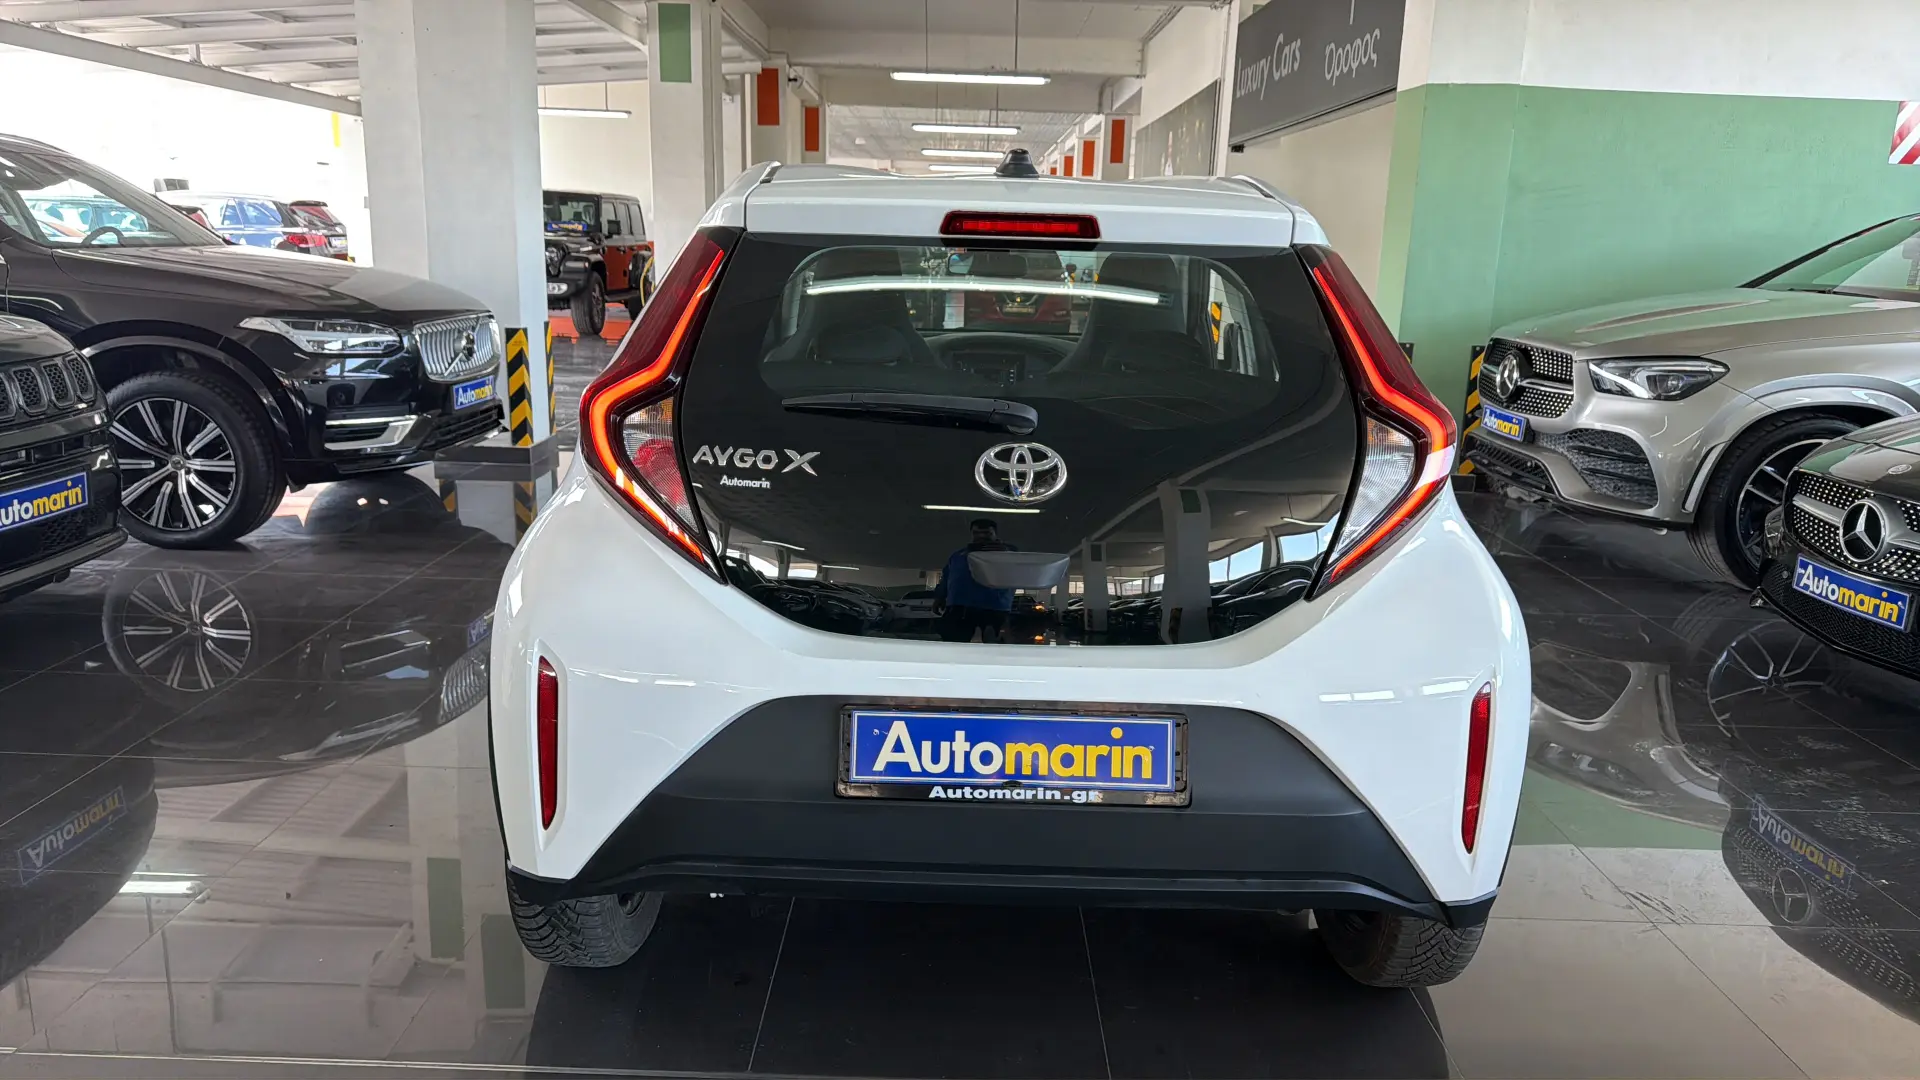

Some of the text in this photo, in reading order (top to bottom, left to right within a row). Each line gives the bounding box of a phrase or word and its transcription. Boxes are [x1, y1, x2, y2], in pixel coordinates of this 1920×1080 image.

[1236, 33, 1301, 100] Luxury Cars
[692, 445, 778, 469] AYGO
[0, 480, 82, 525] utomarin
[720, 475, 771, 489] Automarin
[1800, 564, 1899, 622] Automarin
[872, 720, 1153, 779] Automarin
[928, 785, 1103, 803] Automarin.gr
